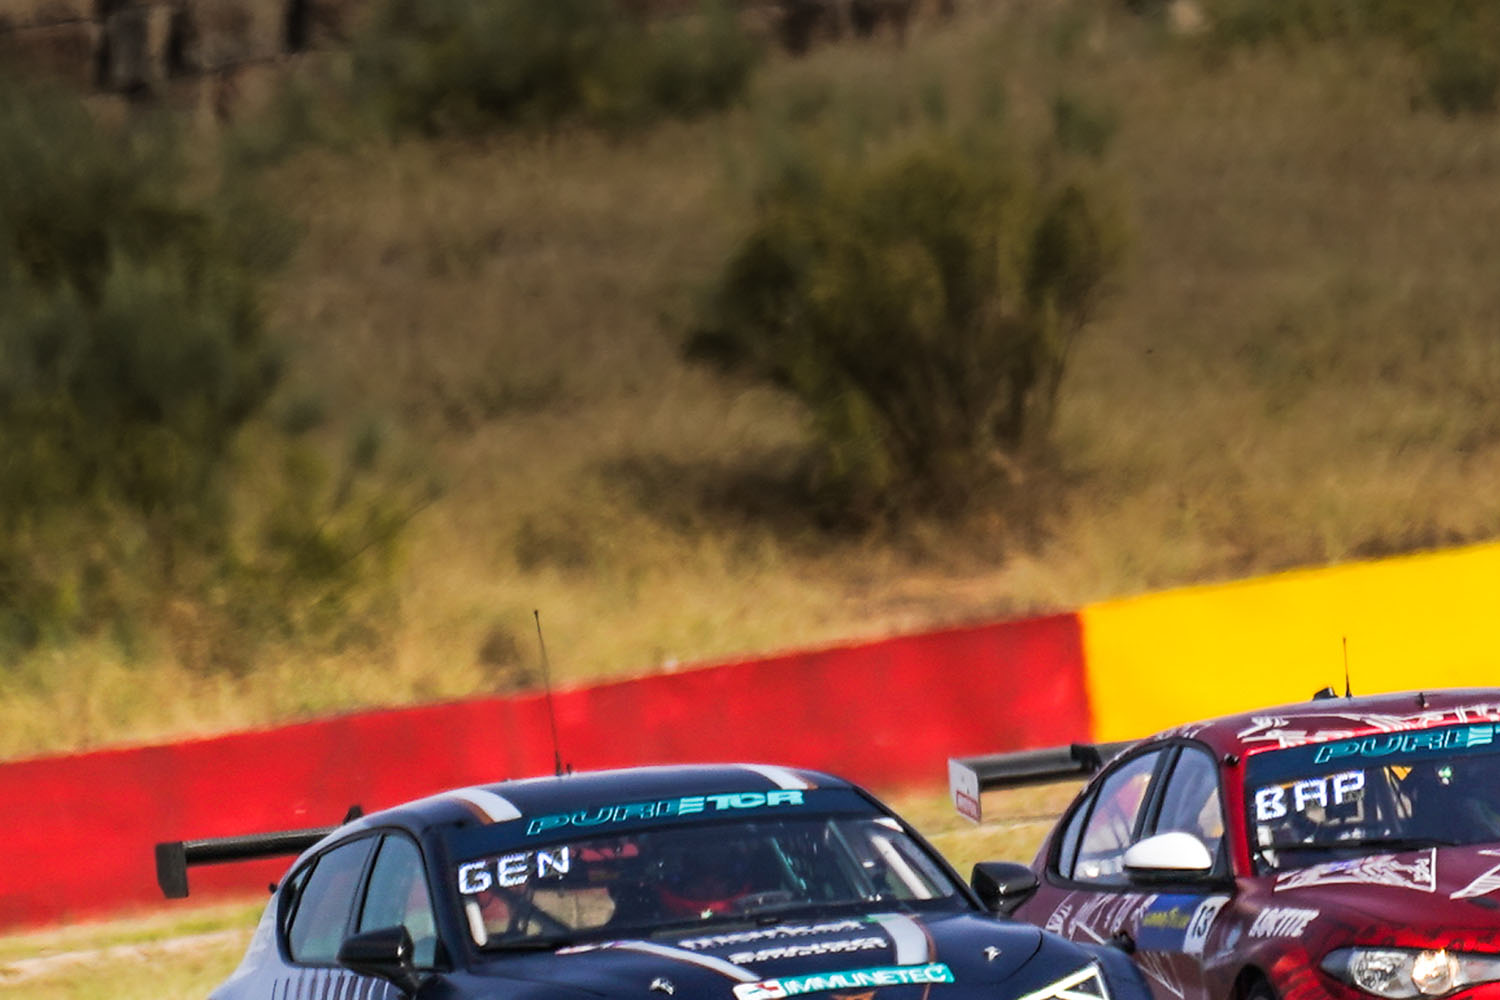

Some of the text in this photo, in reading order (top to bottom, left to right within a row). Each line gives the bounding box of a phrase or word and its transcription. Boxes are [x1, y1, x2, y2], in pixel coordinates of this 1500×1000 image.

[457, 846, 570, 896] GEN
[1249, 907, 1319, 938] LOCTITE
[785, 965, 948, 995] IMMUNETEC
